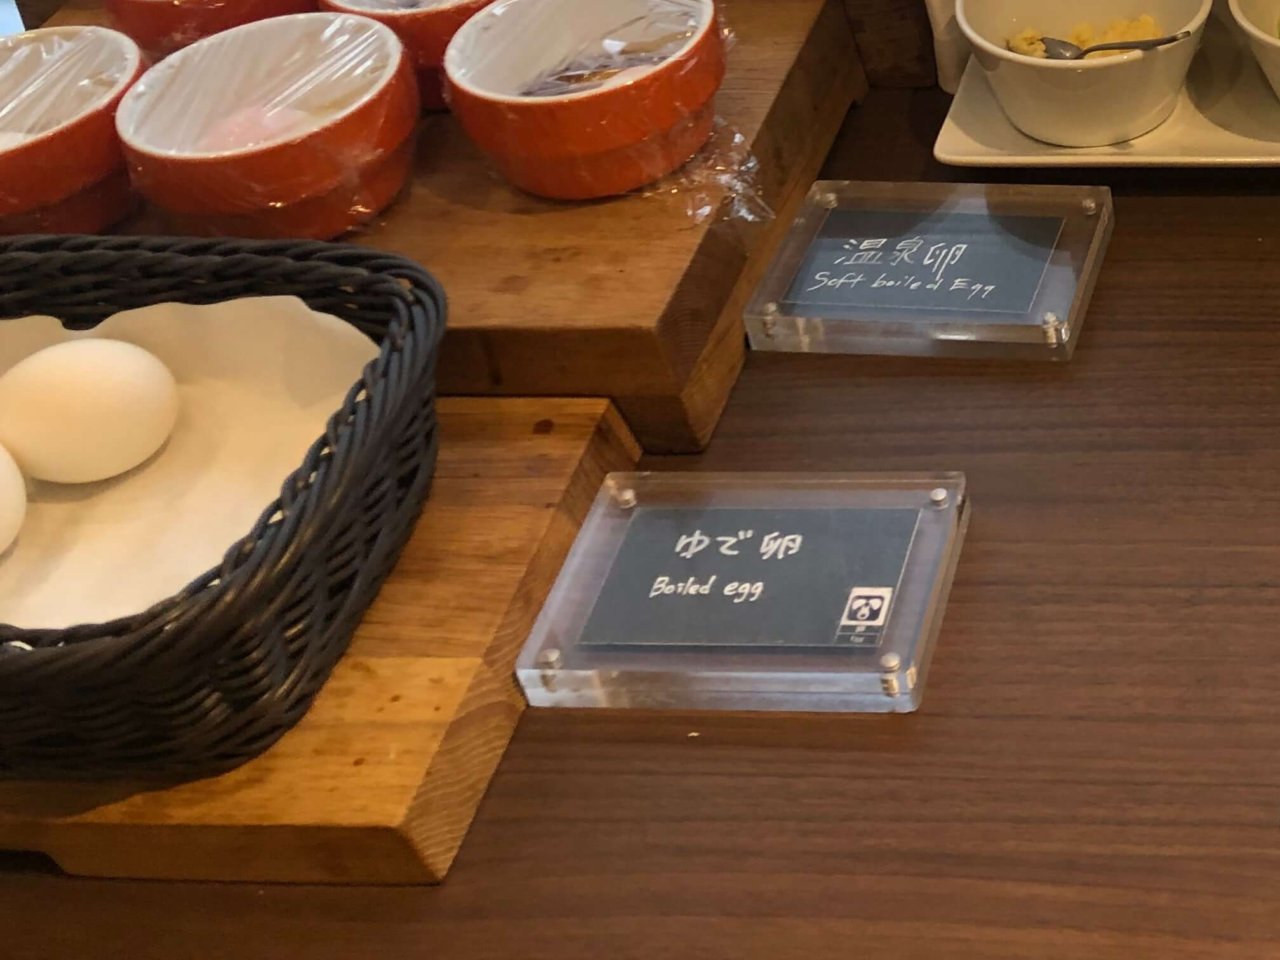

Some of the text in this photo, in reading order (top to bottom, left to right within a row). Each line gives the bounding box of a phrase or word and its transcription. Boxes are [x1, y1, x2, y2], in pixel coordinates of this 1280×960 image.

[833, 235, 969, 278] 温泉卵
[806, 271, 997, 301] Soft boiled Egg
[674, 528, 804, 560] ゆで卵
[648, 574, 765, 603] Boiled egg
